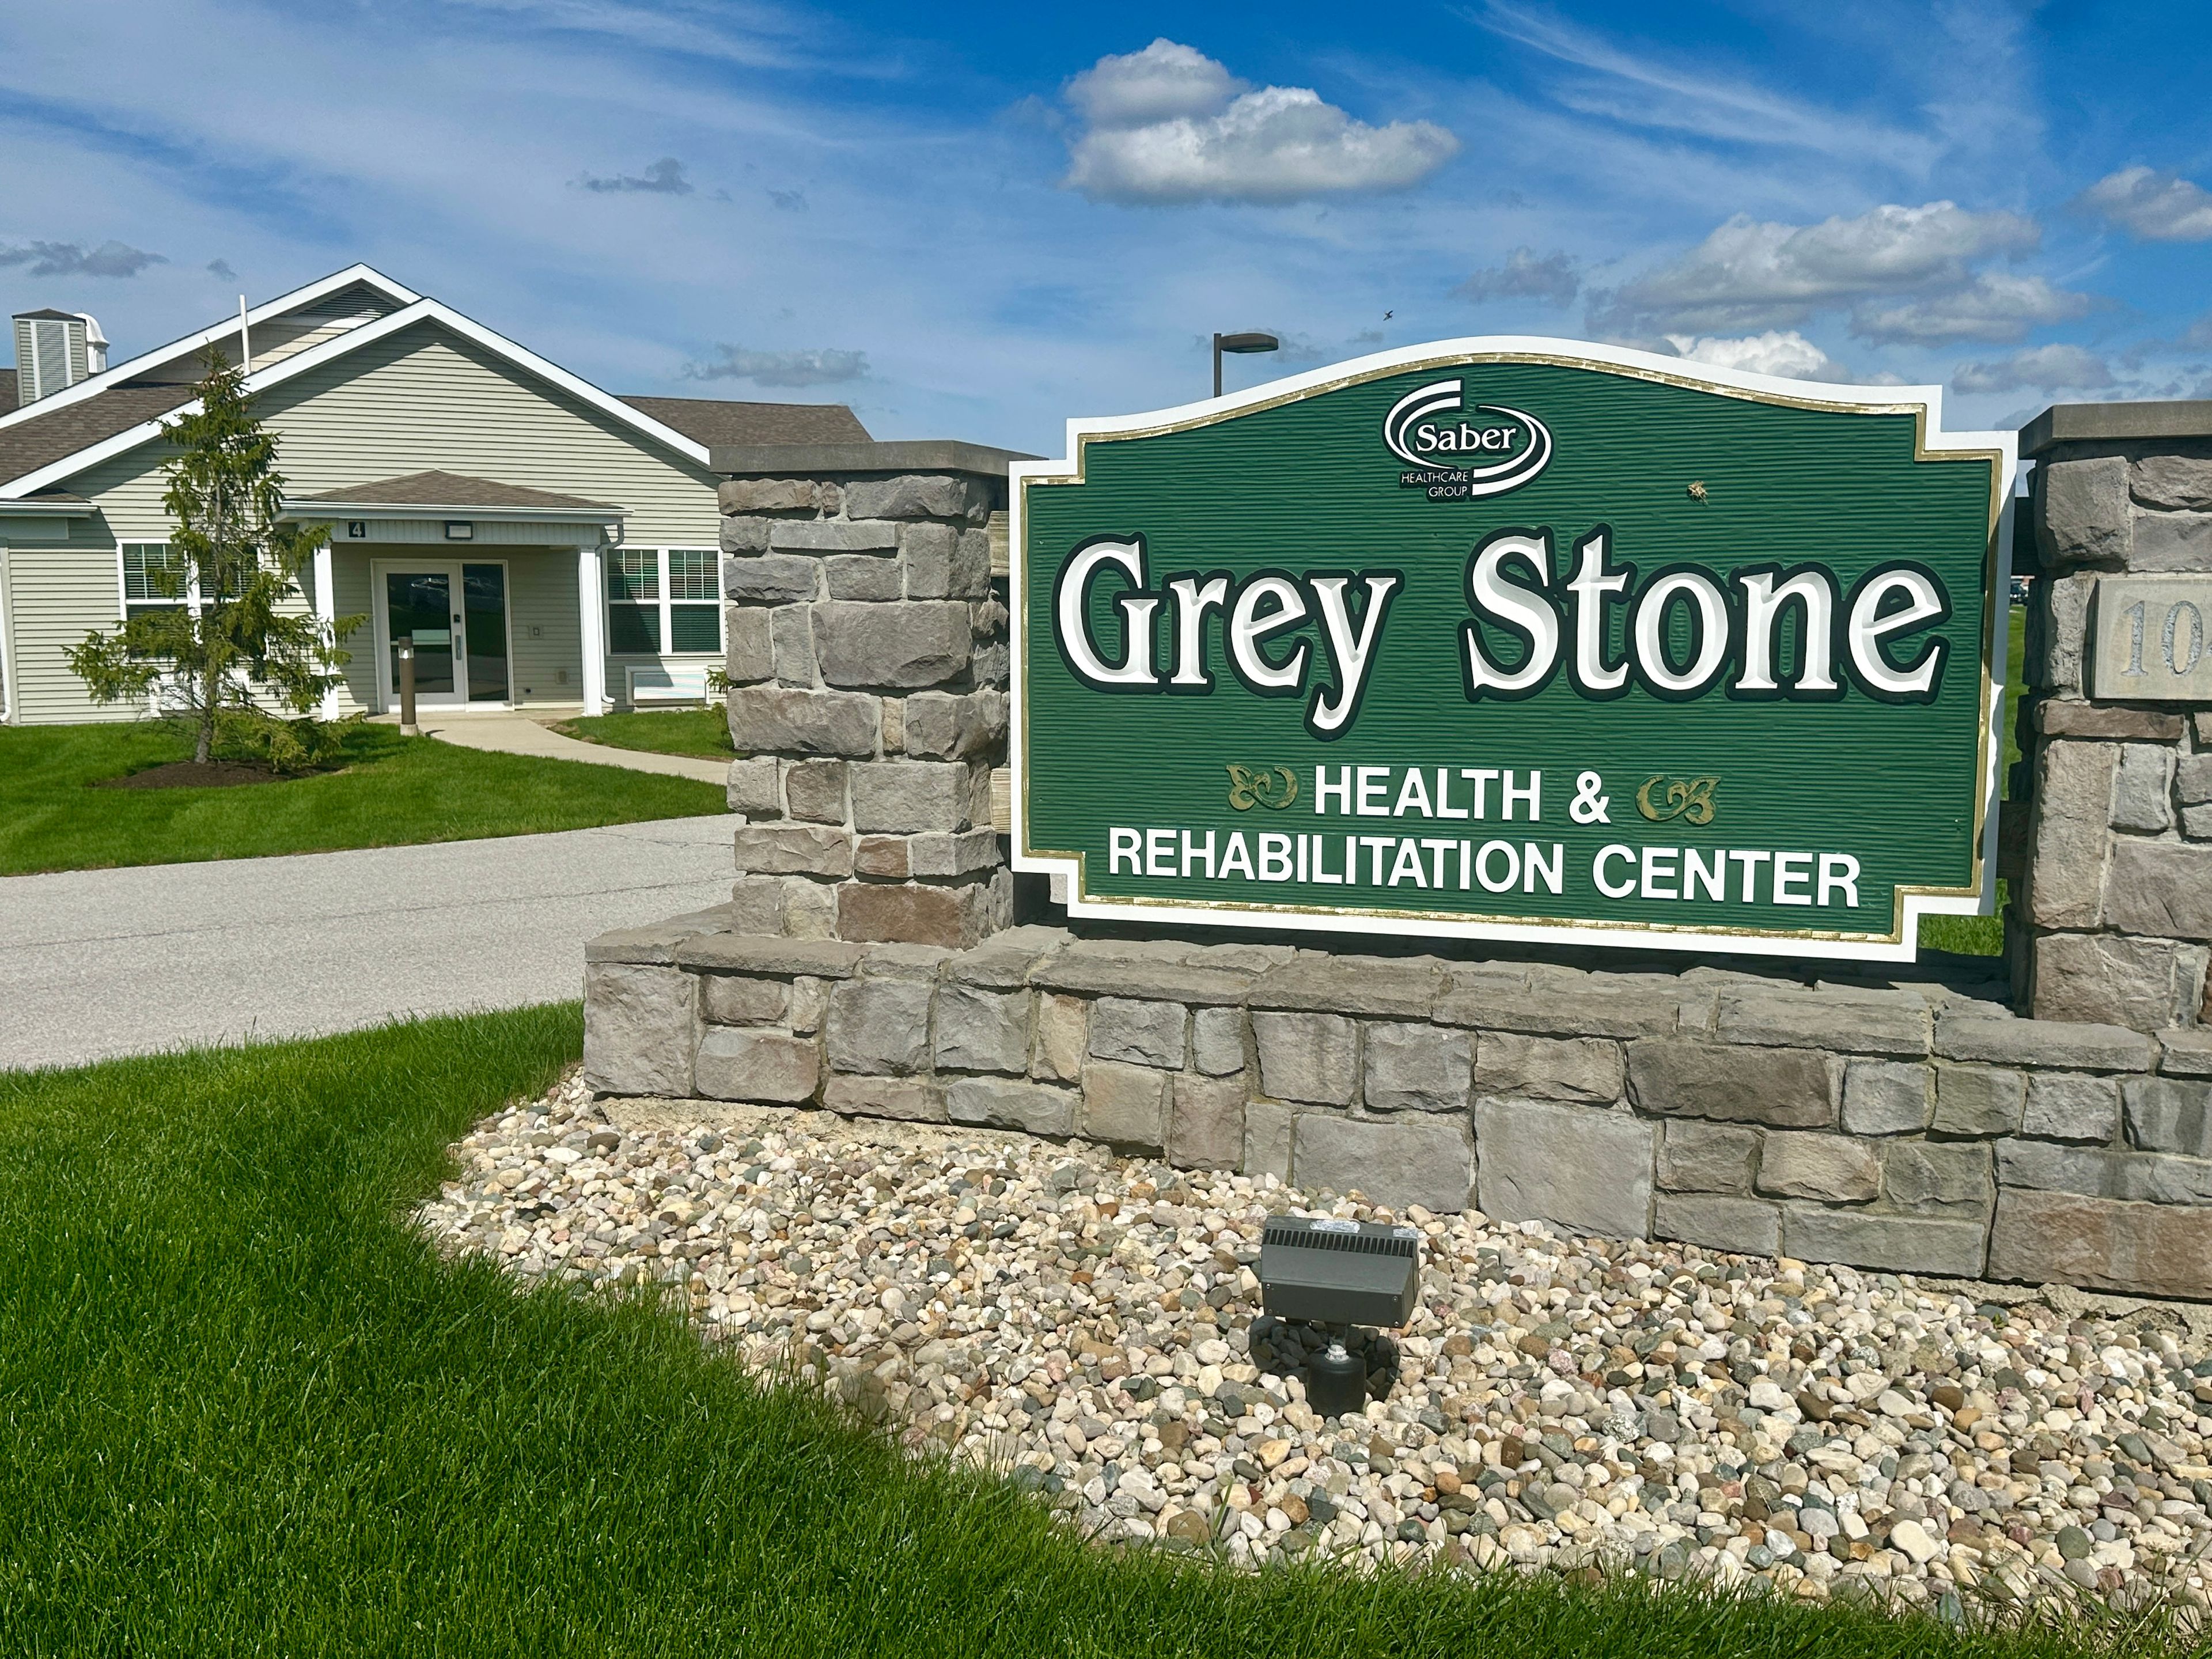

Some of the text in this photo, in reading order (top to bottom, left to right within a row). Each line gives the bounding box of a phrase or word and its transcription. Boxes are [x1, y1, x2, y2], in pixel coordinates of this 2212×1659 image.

[1415, 423, 1517, 452] Saber
[1401, 471, 1468, 484] HEALTHCARE
[1428, 486, 1468, 498] GROUP
[353, 522, 362, 537] 4
[1058, 533, 1944, 732] Grey Stone
[2120, 600, 2212, 678] 10
[1315, 764, 1611, 824] HEALTH &
[1109, 827, 1861, 907] REHABILITATION CENTER
